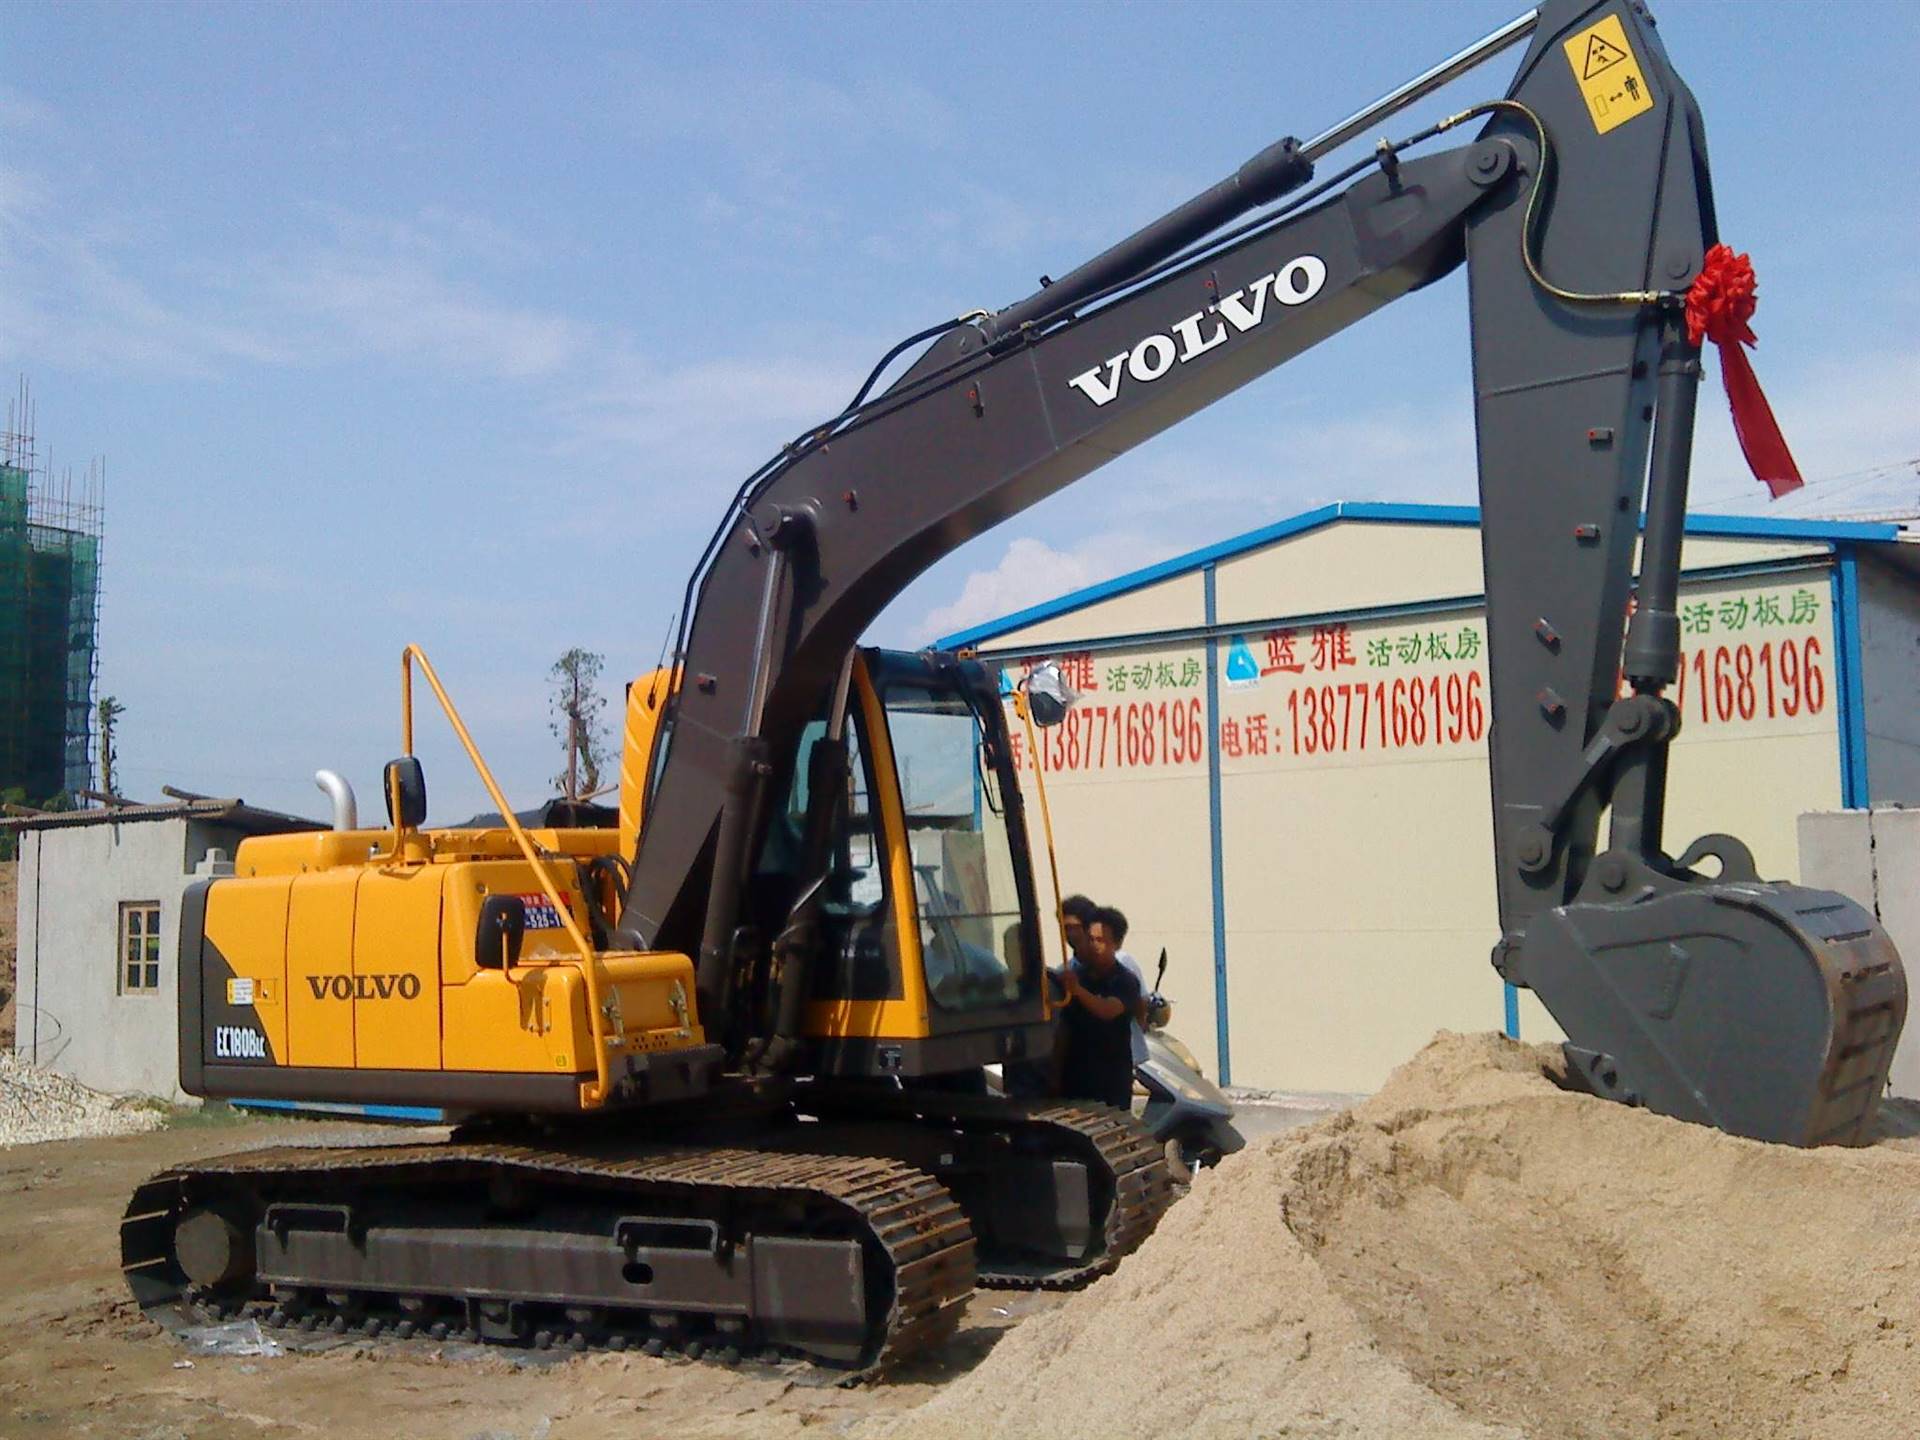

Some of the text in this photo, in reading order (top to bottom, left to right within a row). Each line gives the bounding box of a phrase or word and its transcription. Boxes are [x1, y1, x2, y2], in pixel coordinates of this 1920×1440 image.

[1068, 254, 1327, 406] VOLVO
[1682, 588, 1821, 635] 活动板房
[1106, 657, 1203, 692] 活动板房
[1260, 624, 1482, 677] 蓝雅 活动板房
[1287, 670, 1483, 756] 13877168196
[306, 973, 421, 1000] VOLVO
